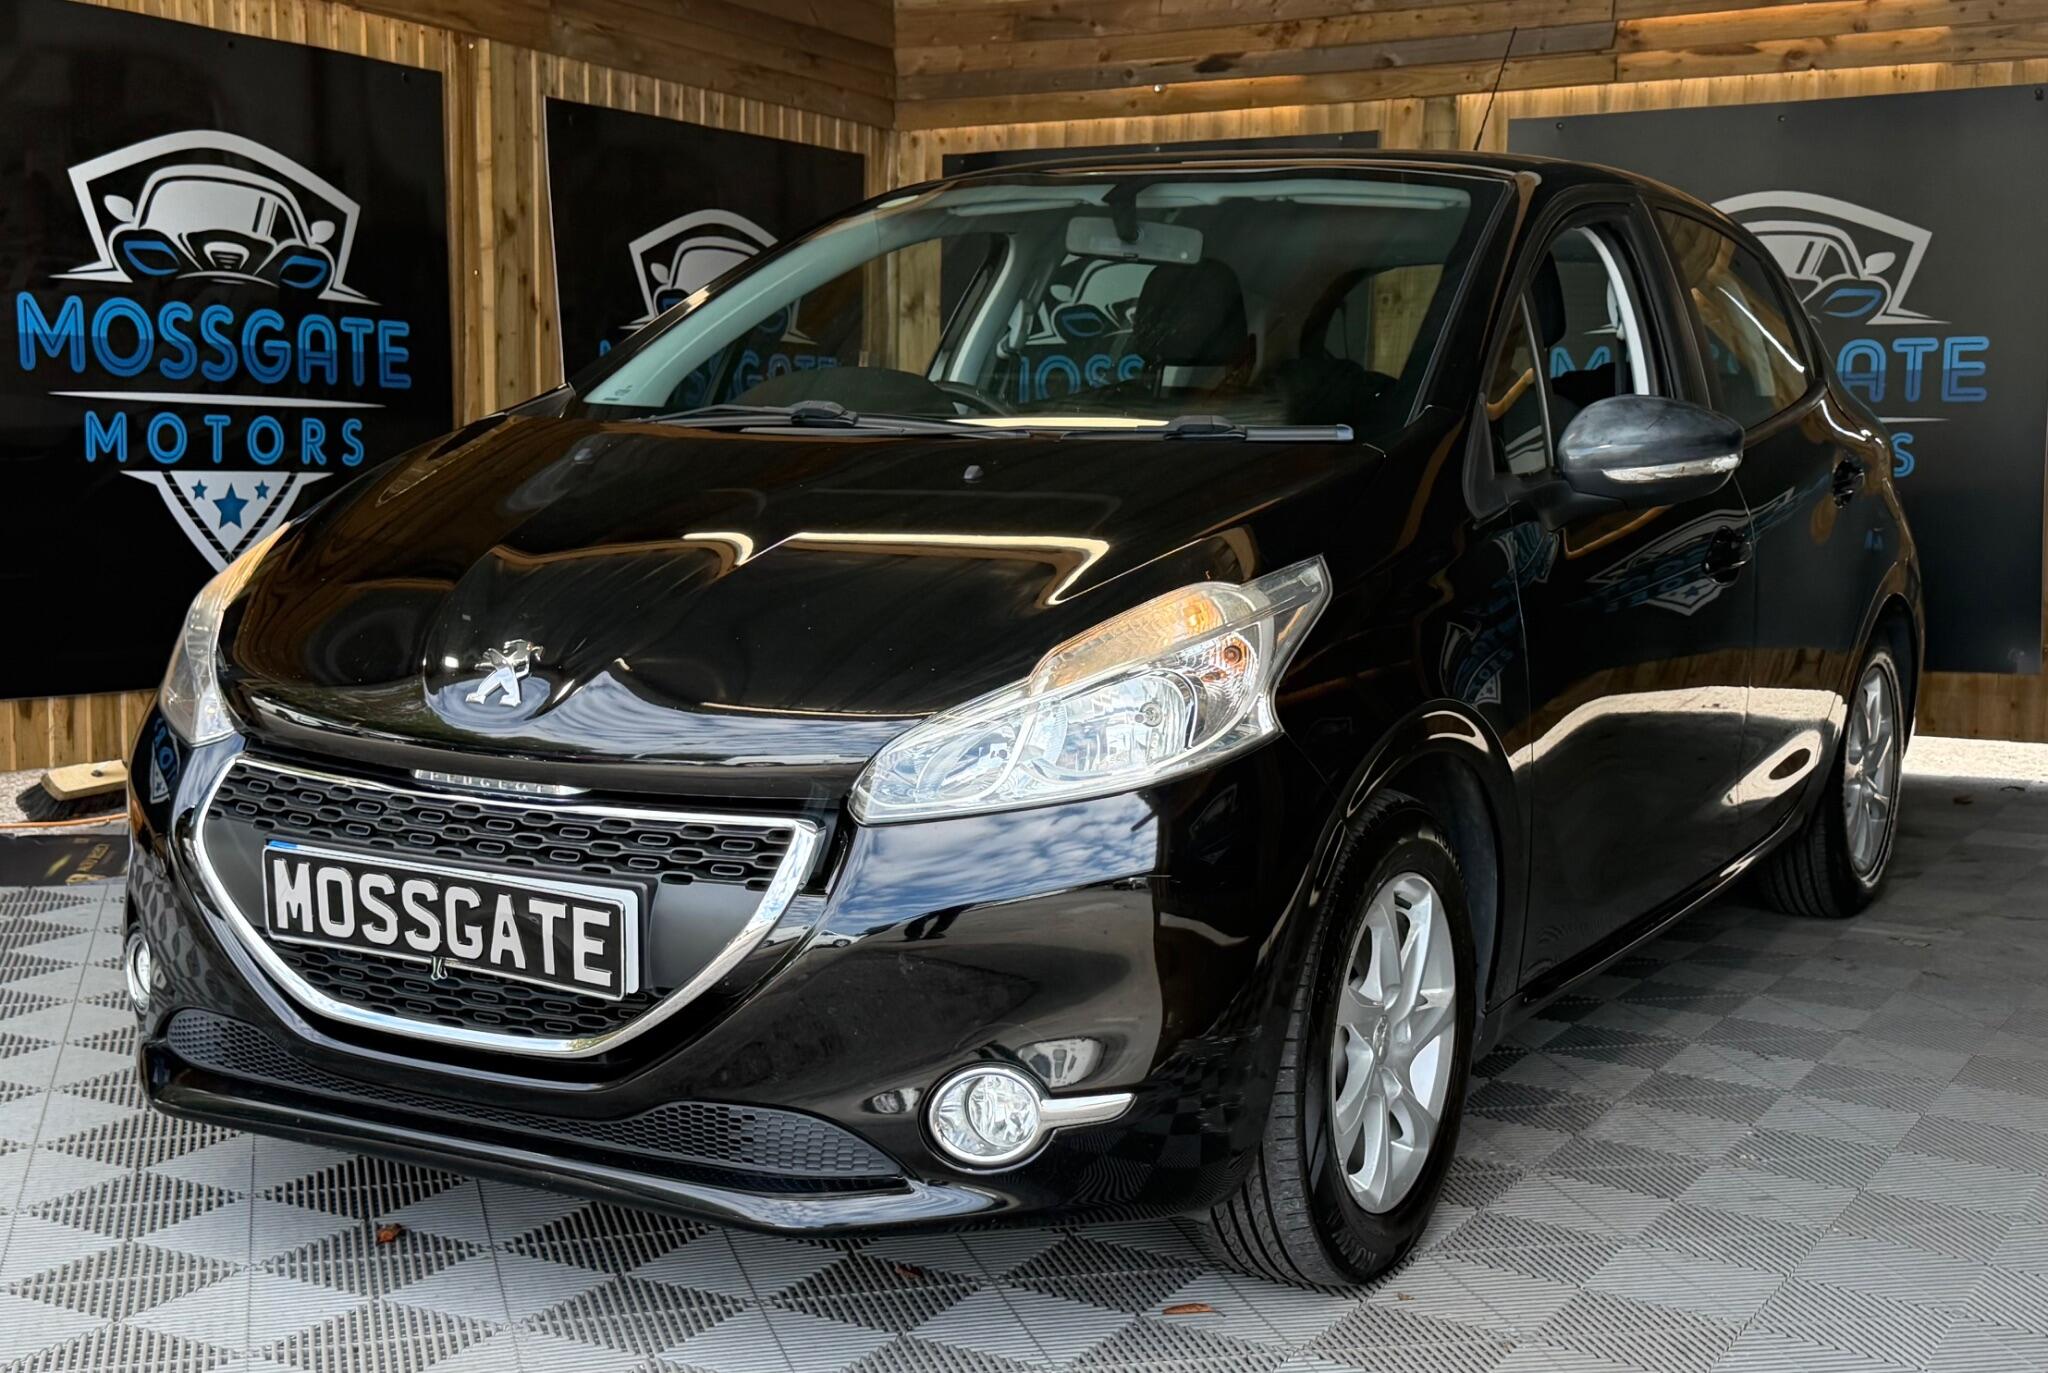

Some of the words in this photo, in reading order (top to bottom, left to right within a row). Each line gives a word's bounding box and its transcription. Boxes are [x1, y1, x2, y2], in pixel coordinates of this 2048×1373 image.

[16, 290, 412, 389] MOSSGATE
[84, 410, 365, 467] MOTORS
[430, 770, 544, 794] PEUGEOT
[272, 858, 613, 987] MOSSGATE
